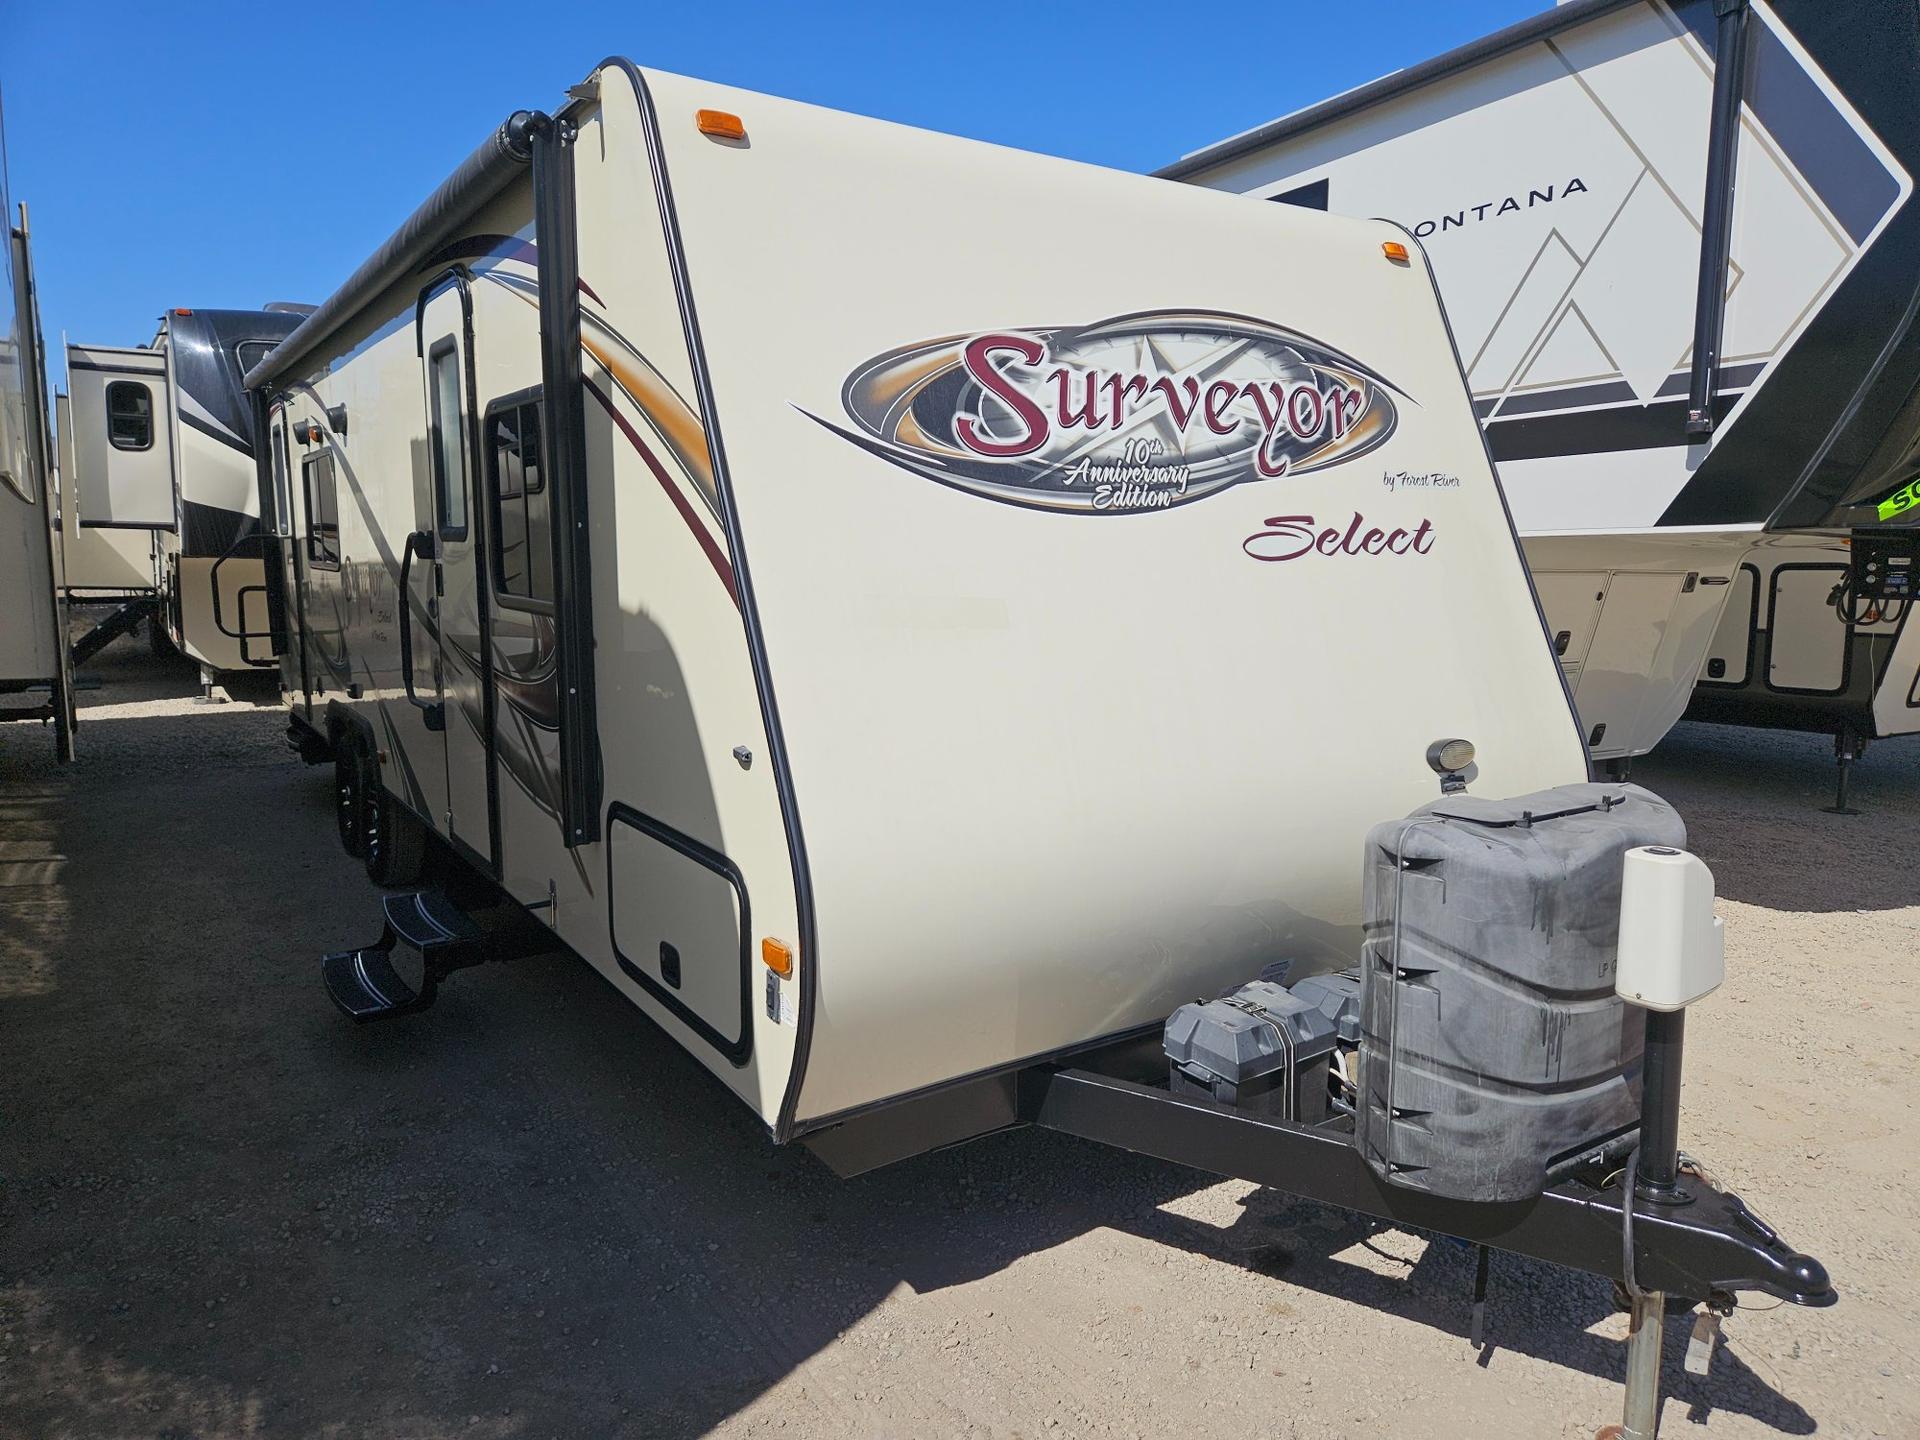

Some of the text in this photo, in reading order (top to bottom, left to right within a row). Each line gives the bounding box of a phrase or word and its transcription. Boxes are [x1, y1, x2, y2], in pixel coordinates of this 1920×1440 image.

[1412, 177, 1588, 238] ONTANA
[955, 333, 1364, 478] Surveyor
[1125, 437, 1164, 465] 10th
[1062, 457, 1189, 493] Anniversary
[1383, 471, 1460, 492] by Forest River
[1092, 482, 1172, 509] Edition
[1243, 511, 1436, 562] Select
